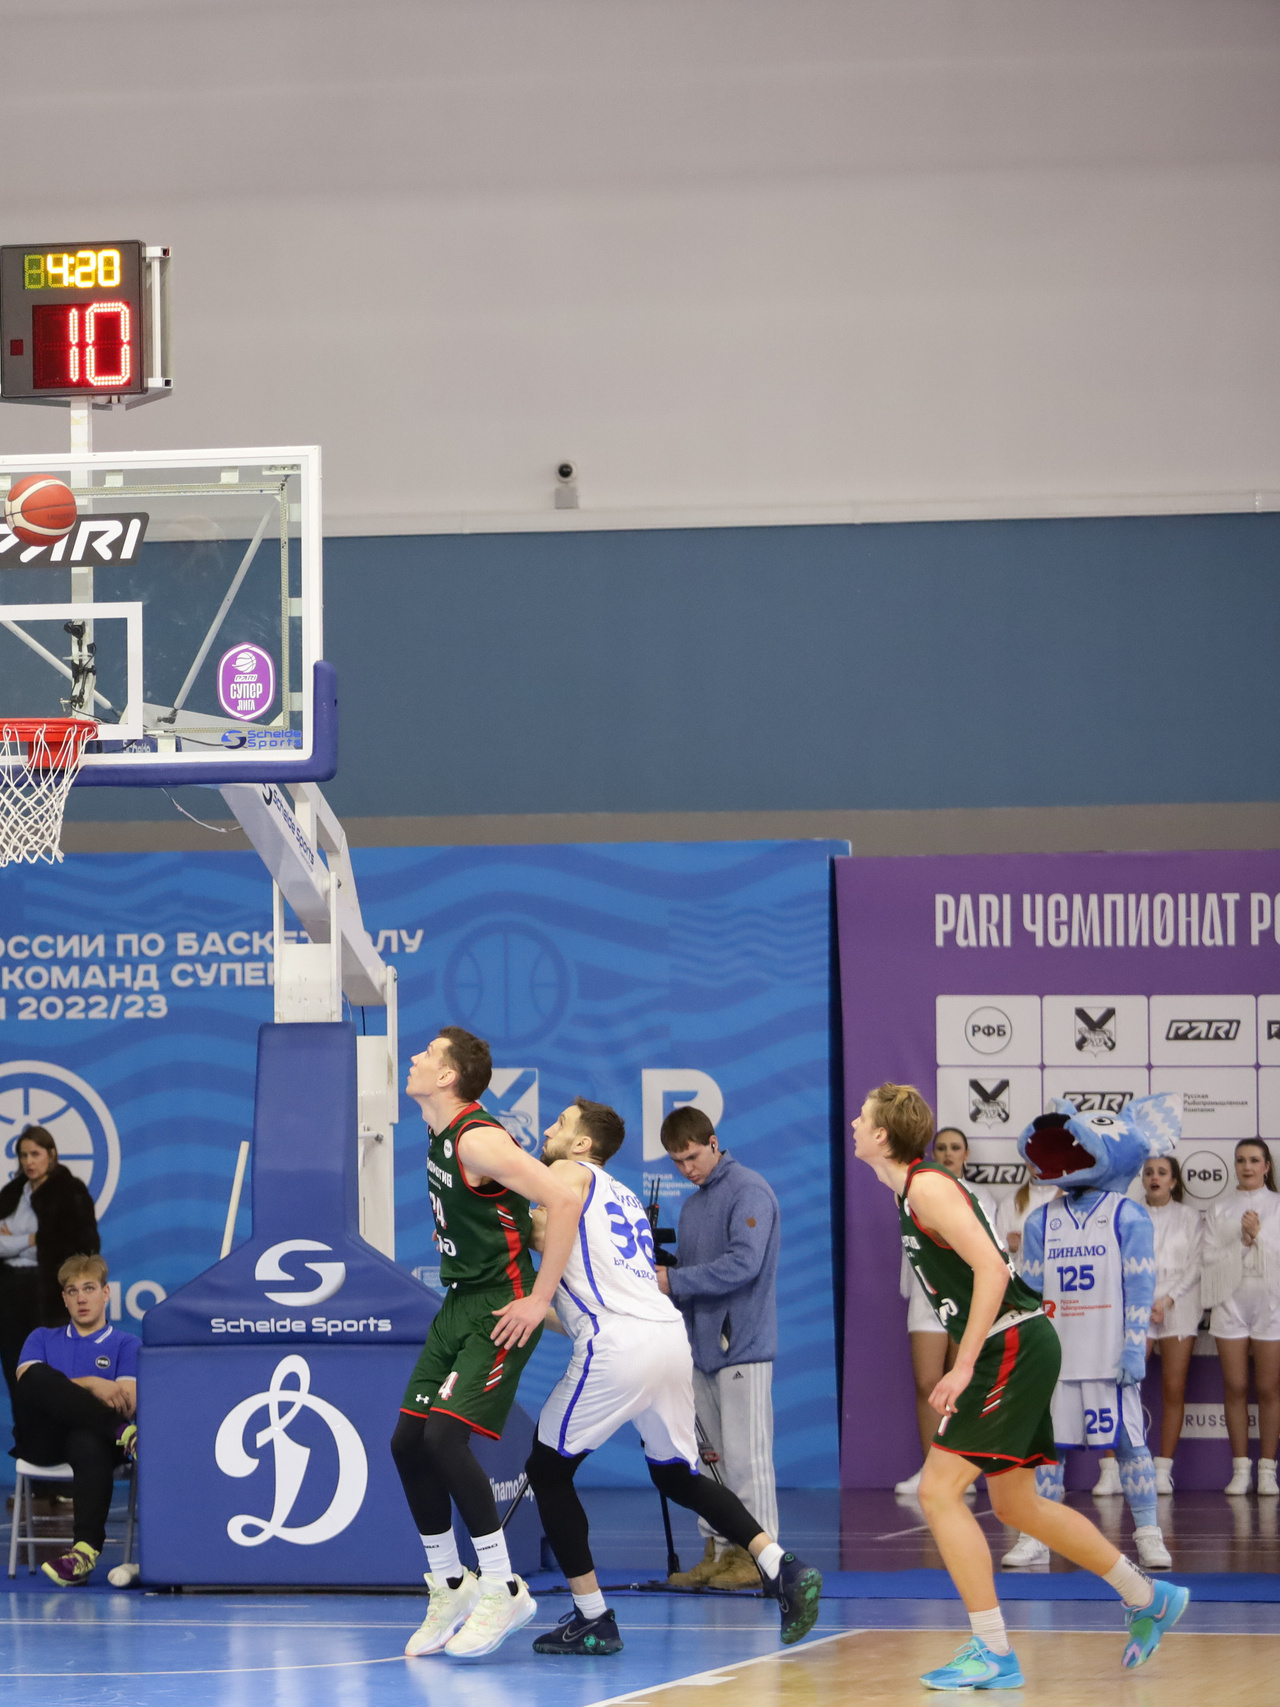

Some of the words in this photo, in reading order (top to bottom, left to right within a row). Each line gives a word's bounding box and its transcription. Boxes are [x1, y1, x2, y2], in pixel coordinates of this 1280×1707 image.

[46, 249, 121, 288] 4:20
[69, 302, 130, 386] 10
[230, 683, 263, 699] СУПЕР
[247, 729, 303, 739] Schelde
[934, 893, 1012, 947] PARI
[1250, 892, 1280, 946] Р
[117, 933, 166, 957] ПО
[2, 965, 160, 991] КОМАНД
[18, 994, 168, 1020] 2022/23
[971, 1023, 1007, 1037] РФБ
[1168, 1021, 1239, 1039] PARI
[1187, 1168, 1223, 1182] РФБ
[1047, 1245, 1107, 1260] ДИНАМО
[1056, 1264, 1095, 1292] 125
[210, 1317, 307, 1334] Schelde
[311, 1316, 393, 1336] Sports
[1084, 1408, 1114, 1434] 25
